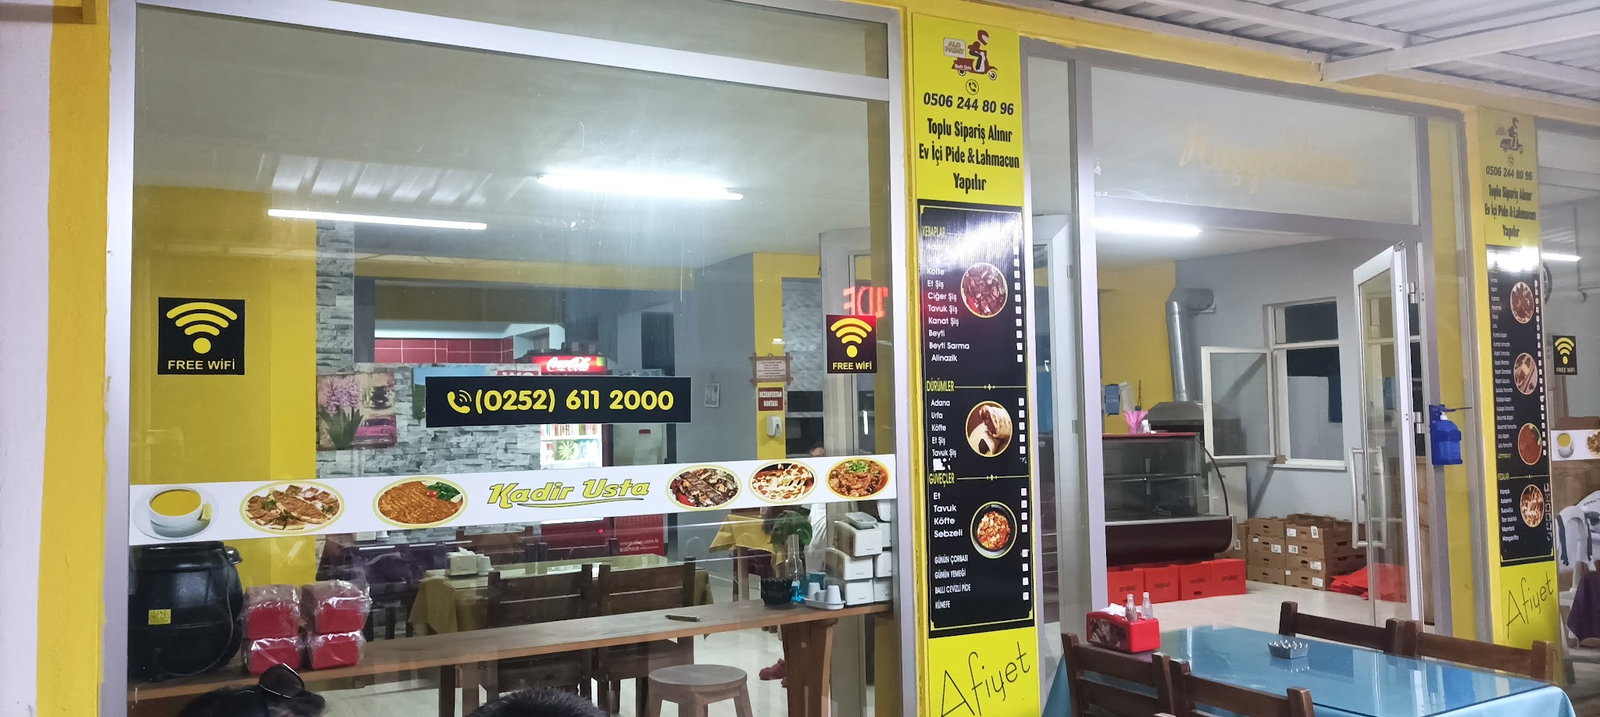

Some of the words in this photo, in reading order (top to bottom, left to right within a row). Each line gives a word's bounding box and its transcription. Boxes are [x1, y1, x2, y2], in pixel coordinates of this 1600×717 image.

[923, 92, 953, 108] 0506
[957, 96, 979, 110] 244
[982, 100, 996, 113] 80
[1000, 102, 1014, 116] 96
[927, 118, 952, 140] Toplu
[954, 120, 986, 144] Sipariş
[988, 125, 1012, 142] Alınır
[919, 144, 929, 160] Ev
[932, 141, 942, 166] İçi
[946, 146, 965, 164] Pide
[1486, 165, 1502, 176] 0506
[1502, 168, 1514, 178] 244
[1516, 170, 1524, 180] 80
[1525, 171, 1532, 181] 96
[953, 173, 986, 194] Yapılır
[928, 292, 946, 301] Ciğer
[948, 292, 957, 302] Şiş
[928, 304, 948, 312] Tavuk
[949, 305, 958, 314] Şiş
[950, 317, 959, 327] Şiş
[929, 329, 945, 338] Beyti
[929, 342, 945, 350] Beyti
[947, 342, 970, 350] Sarma
[168, 360, 204, 370] FREE
[832, 362, 854, 370] FREE
[926, 378, 955, 392] DÜRÜMLER
[474, 388, 556, 414] (0252)
[566, 390, 600, 410] 611
[609, 390, 675, 411] 2000
[930, 399, 951, 407] Adana
[931, 424, 946, 432] Köfte
[932, 449, 948, 457] Tavuk
[486, 482, 574, 510] Kadir
[582, 478, 650, 499] Usta
[933, 492, 941, 500] Et
[934, 504, 957, 512] Tavuk
[934, 517, 955, 525] Köfte
[934, 529, 963, 538] Sebzeli
[934, 554, 949, 564] GÜNÜN
[934, 569, 950, 579] GÜNÜN
[935, 586, 945, 594] BALLI
[935, 600, 951, 610] KÜNEFE
[1506, 570, 1554, 640] Afiyet
[940, 641, 1031, 717] Afiyet
